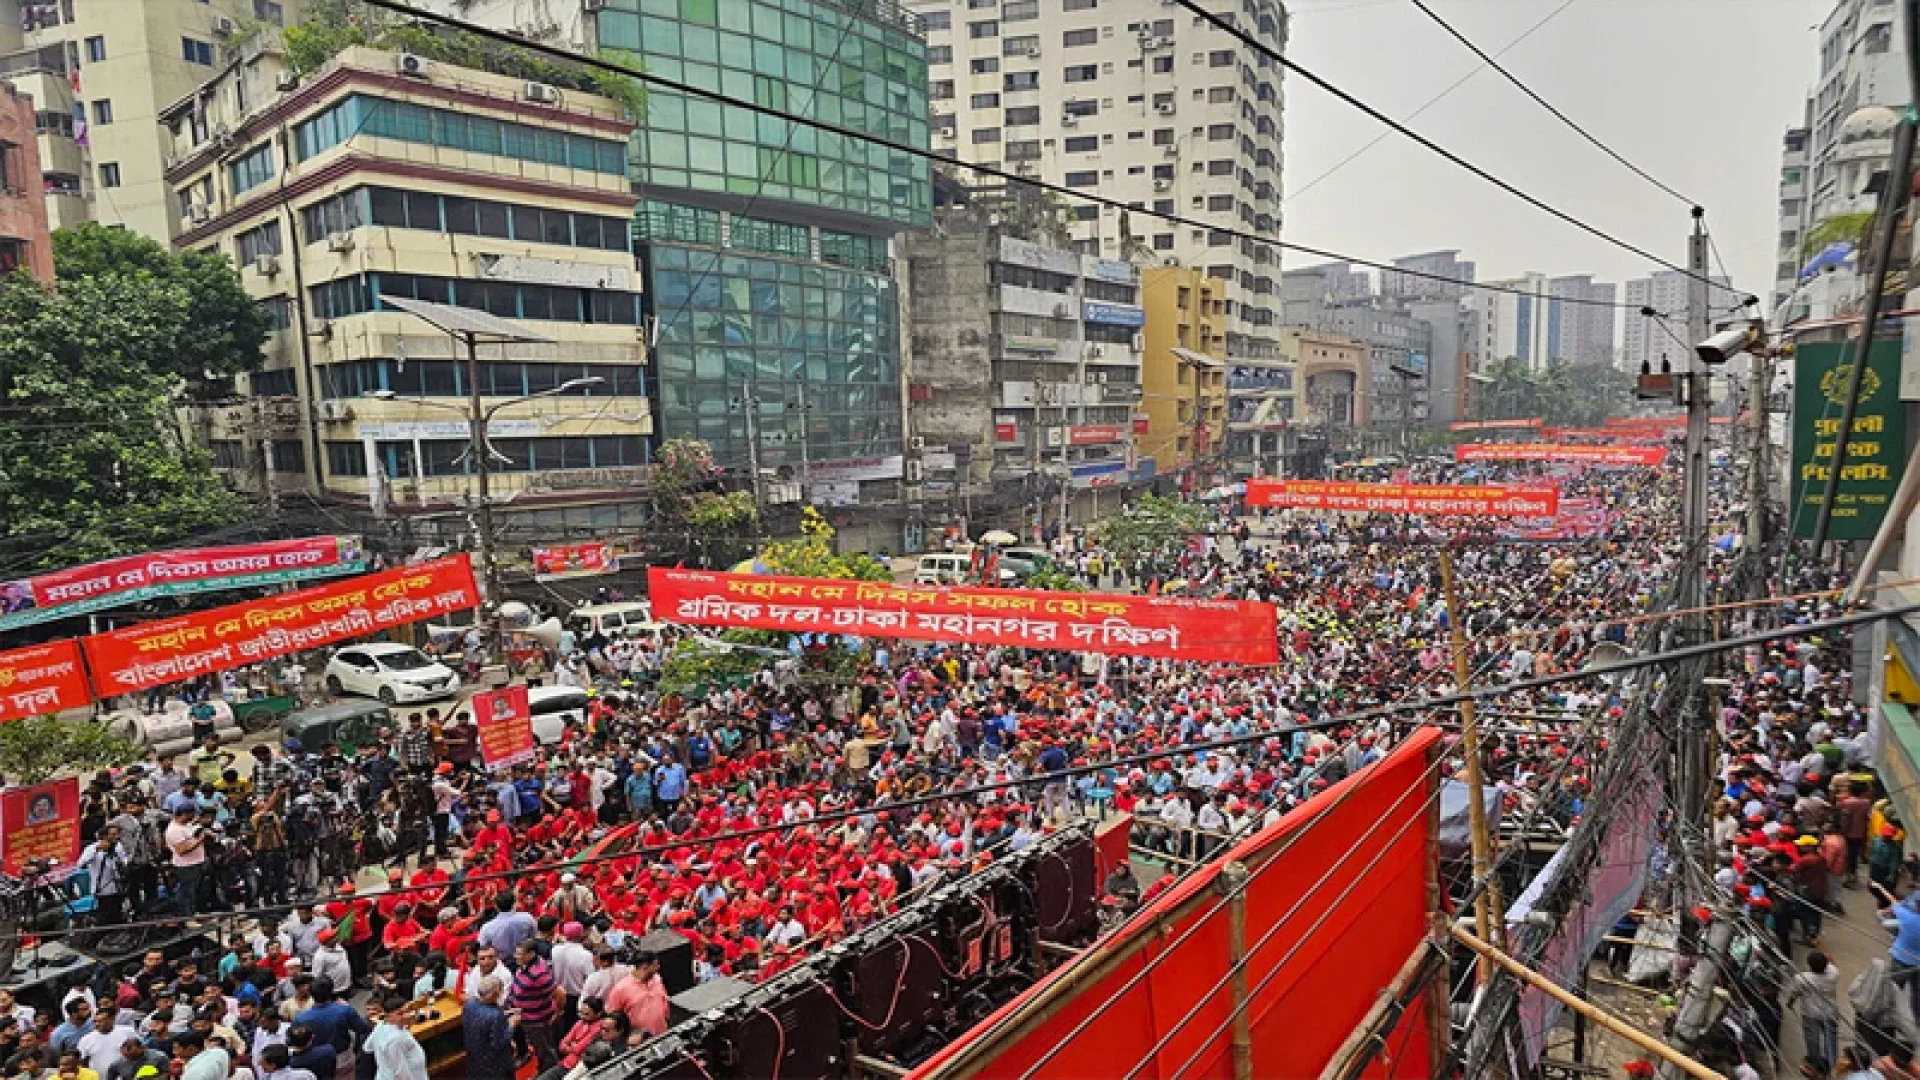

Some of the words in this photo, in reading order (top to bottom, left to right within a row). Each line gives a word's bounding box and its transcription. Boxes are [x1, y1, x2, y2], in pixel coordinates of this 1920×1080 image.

[1814, 415, 1884, 436] পূবলী
[45, 576, 110, 600] মহান
[117, 568, 144, 586] মে
[148, 560, 207, 577] দিবস
[211, 554, 270, 570] অমর
[274, 550, 322, 564] হোক
[727, 579, 803, 599] মহান
[810, 586, 848, 601] মে
[856, 583, 936, 606] দিবস
[947, 590, 1036, 612] সফল
[1045, 599, 1130, 618] হোক
[110, 643, 232, 685] বাংলাদেশ
[237, 608, 372, 659] জাতীয়তাবাদী
[374, 598, 432, 623] শ্রমিক
[434, 590, 466, 610] দল
[132, 626, 207, 651] মহান
[214, 618, 240, 636] মে
[244, 604, 303, 630] দিবস
[306, 590, 367, 613] অমর
[373, 574, 432, 600] হোক
[676, 596, 761, 621] শ্রমিক
[916, 612, 1059, 642] মহানগর
[1069, 618, 1181, 650] দক্ষিণ
[7, 686, 60, 713] দল
